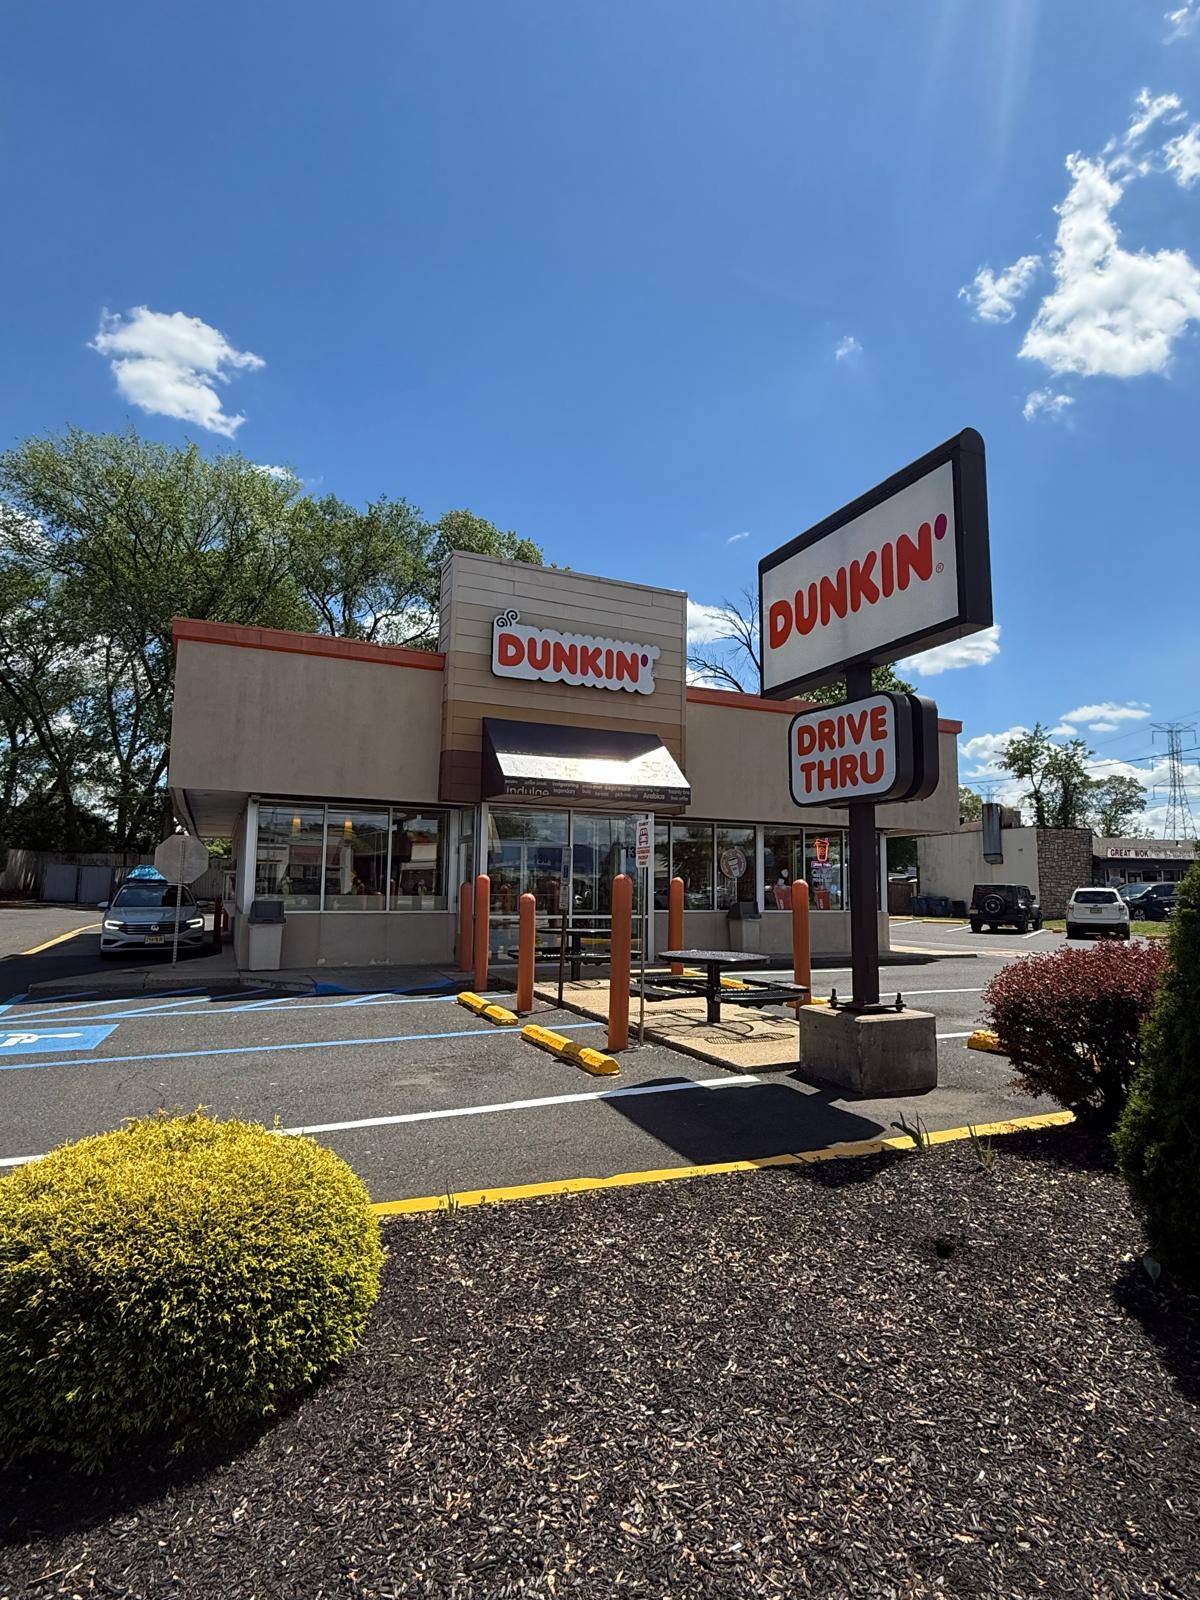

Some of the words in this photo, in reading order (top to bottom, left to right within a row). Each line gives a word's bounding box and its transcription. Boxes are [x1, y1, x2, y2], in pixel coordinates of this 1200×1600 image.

[770, 513, 948, 650] DUNKIN'
[498, 632, 649, 684] DUNKIN'
[797, 705, 888, 757] DRIVE
[800, 748, 885, 794] THRU
[1111, 849, 1131, 857] GREAT
